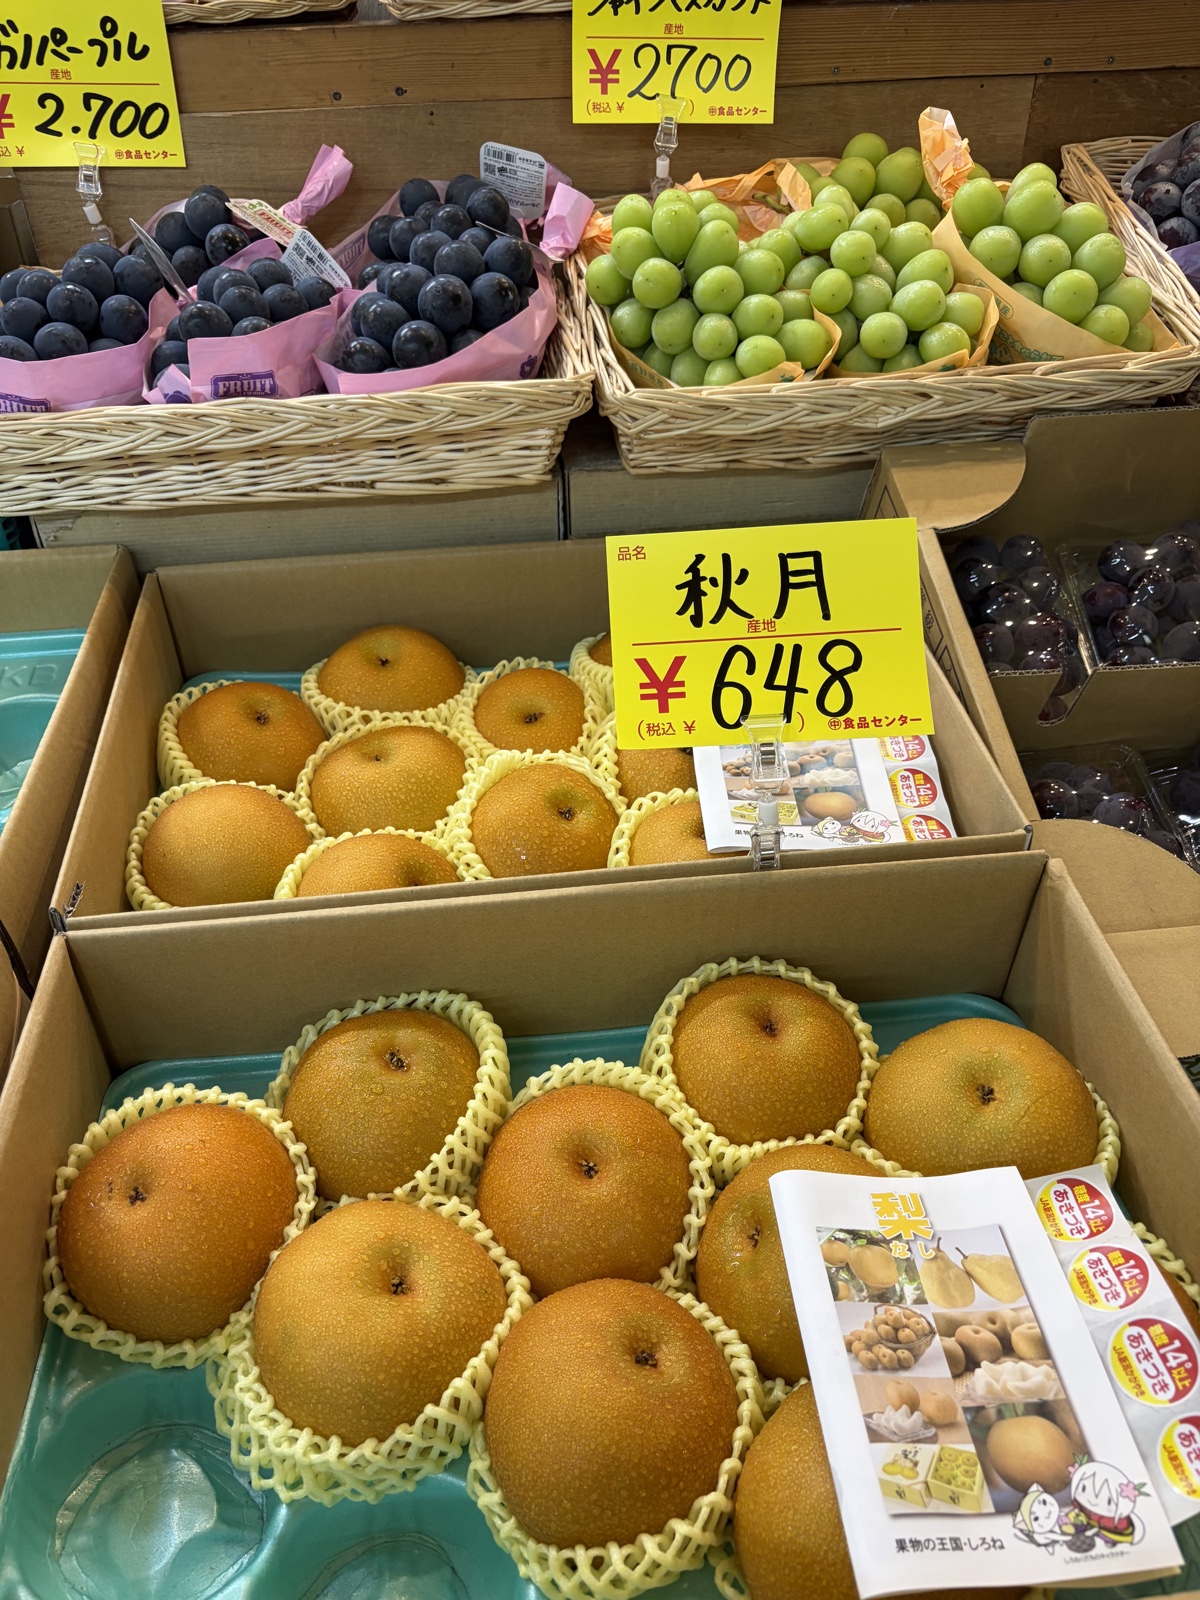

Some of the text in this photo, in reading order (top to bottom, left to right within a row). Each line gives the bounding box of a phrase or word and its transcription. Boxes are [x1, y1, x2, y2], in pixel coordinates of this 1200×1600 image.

[664, 23, 685, 35] 産地
[50, 69, 72, 80] 産地
[217, 378, 274, 396] FRUIT
[617, 546, 646, 561] 品名
[675, 550, 831, 628] 秋月
[747, 619, 776, 633] 産地
[899, 774, 917, 804] あきづき
[912, 819, 930, 840] あきづ
[870, 1191, 935, 1241] 梨
[1053, 1188, 1087, 1237] あきづき
[890, 1241, 936, 1260] なし
[1087, 1256, 1121, 1303] あきづき
[1127, 1331, 1170, 1396] あきづき
[895, 1536, 1005, 1553] 果物の王国・しろね
